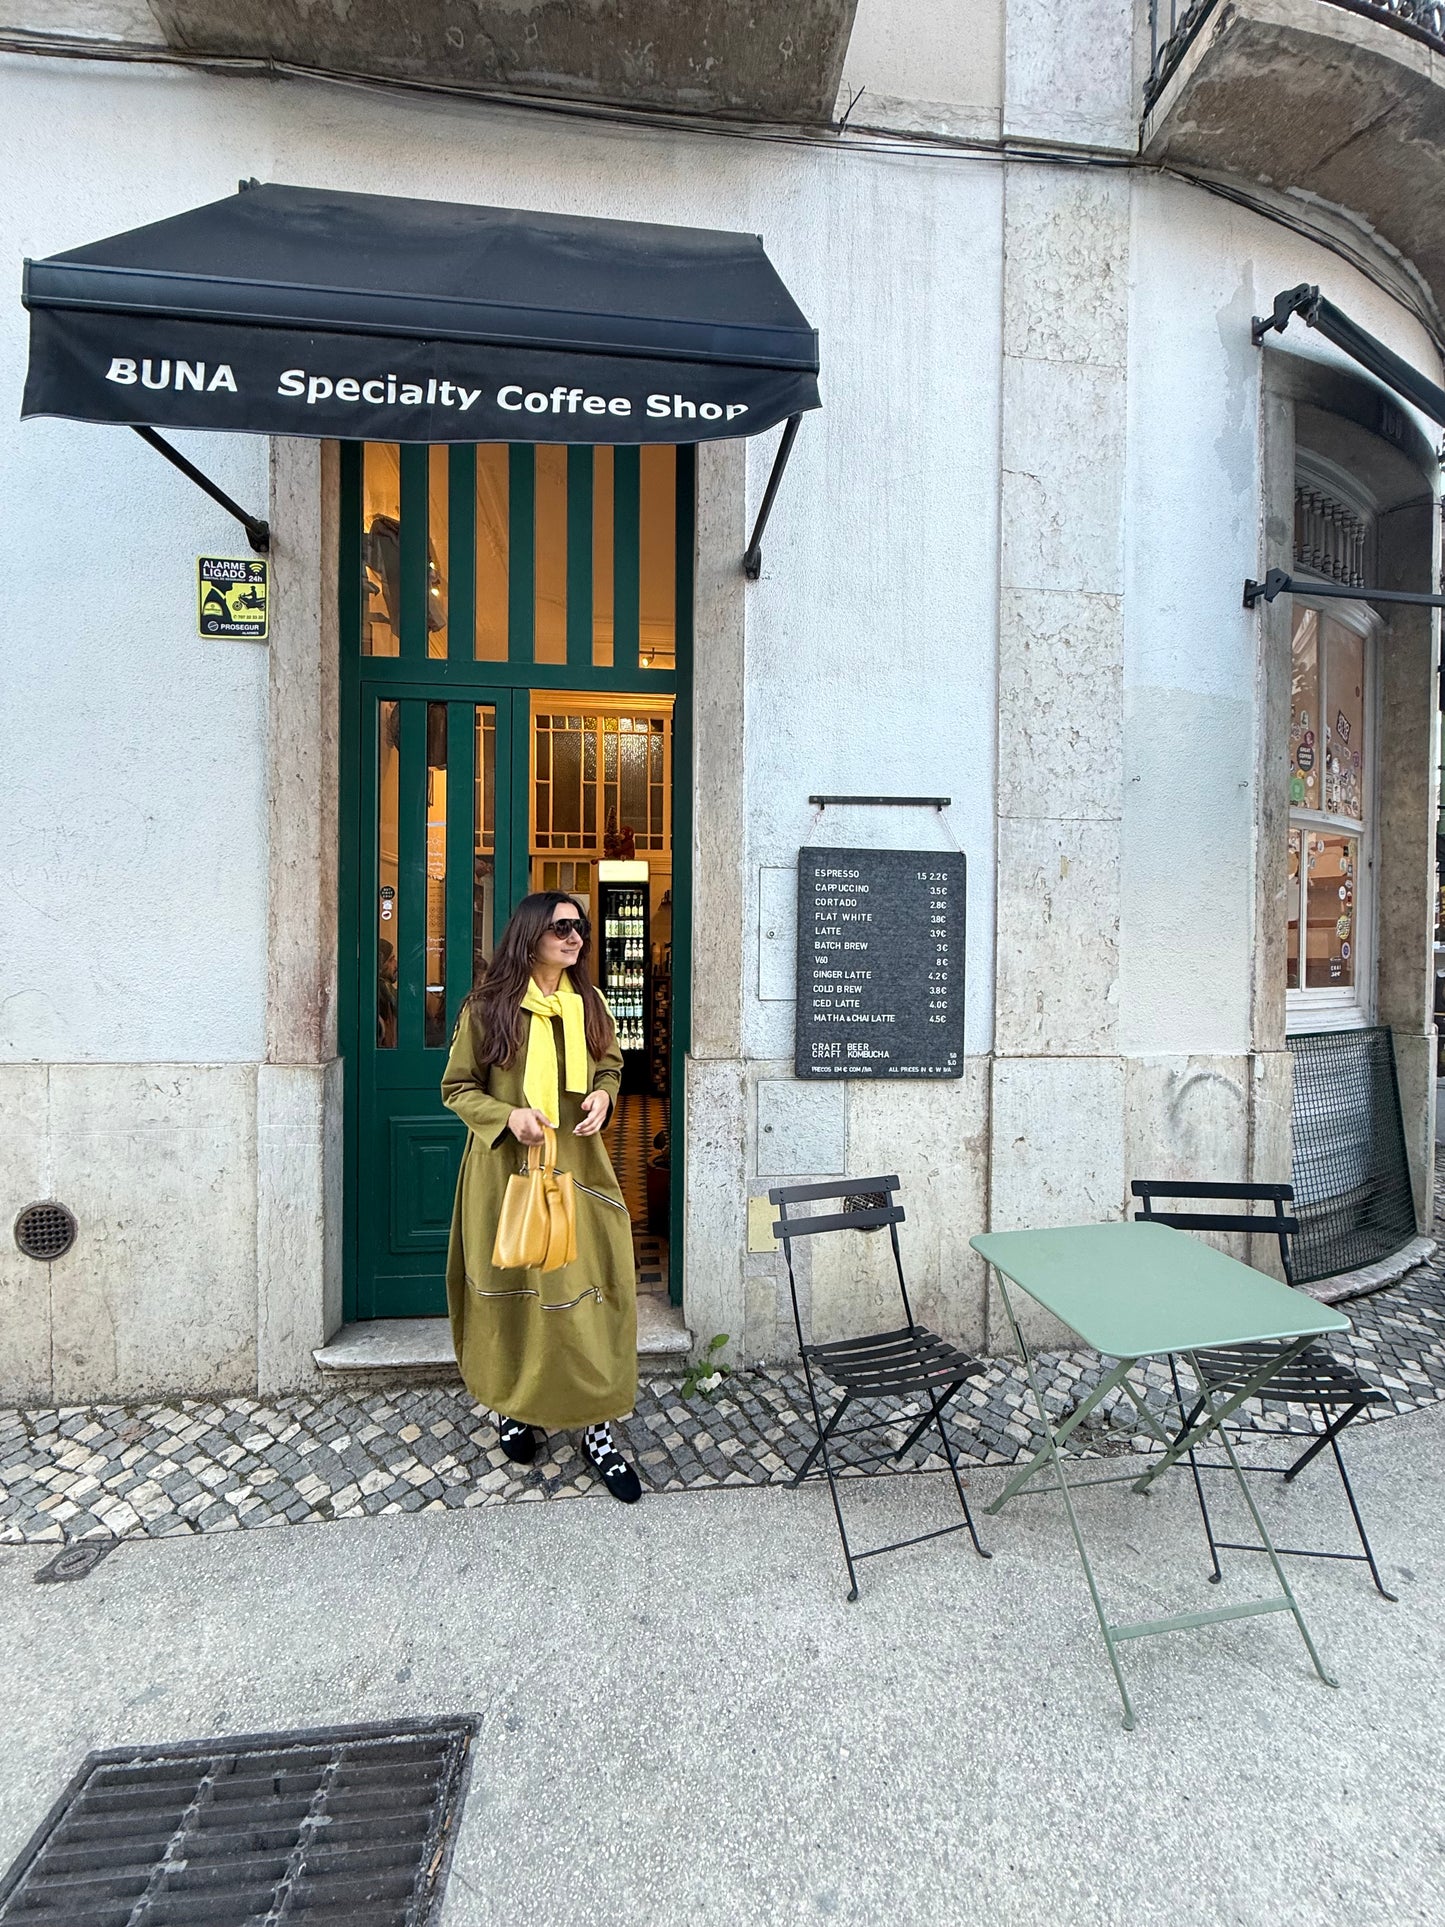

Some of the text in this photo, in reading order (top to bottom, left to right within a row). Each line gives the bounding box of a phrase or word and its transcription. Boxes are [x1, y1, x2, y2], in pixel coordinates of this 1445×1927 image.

[105, 358, 749, 421] BUNA Specialty Coffee Shop
[203, 560, 246, 570] ALARME
[203, 568, 246, 578] LIGADO
[815, 869, 860, 878] ESPRESSO
[815, 884, 869, 893] CAPPUCCINO
[815, 898, 857, 907] CORTADO
[815, 927, 841, 935] LATTE
[844, 942, 868, 950] BREW
[815, 956, 828, 964] V60
[813, 970, 842, 978] GINGER
[845, 971, 872, 979] LATTE
[813, 985, 834, 993] COLD
[835, 1000, 860, 1008] LATTE
[814, 1014, 845, 1022] MATHA
[852, 1014, 869, 1022] CHAI
[871, 1014, 896, 1022] LATTE
